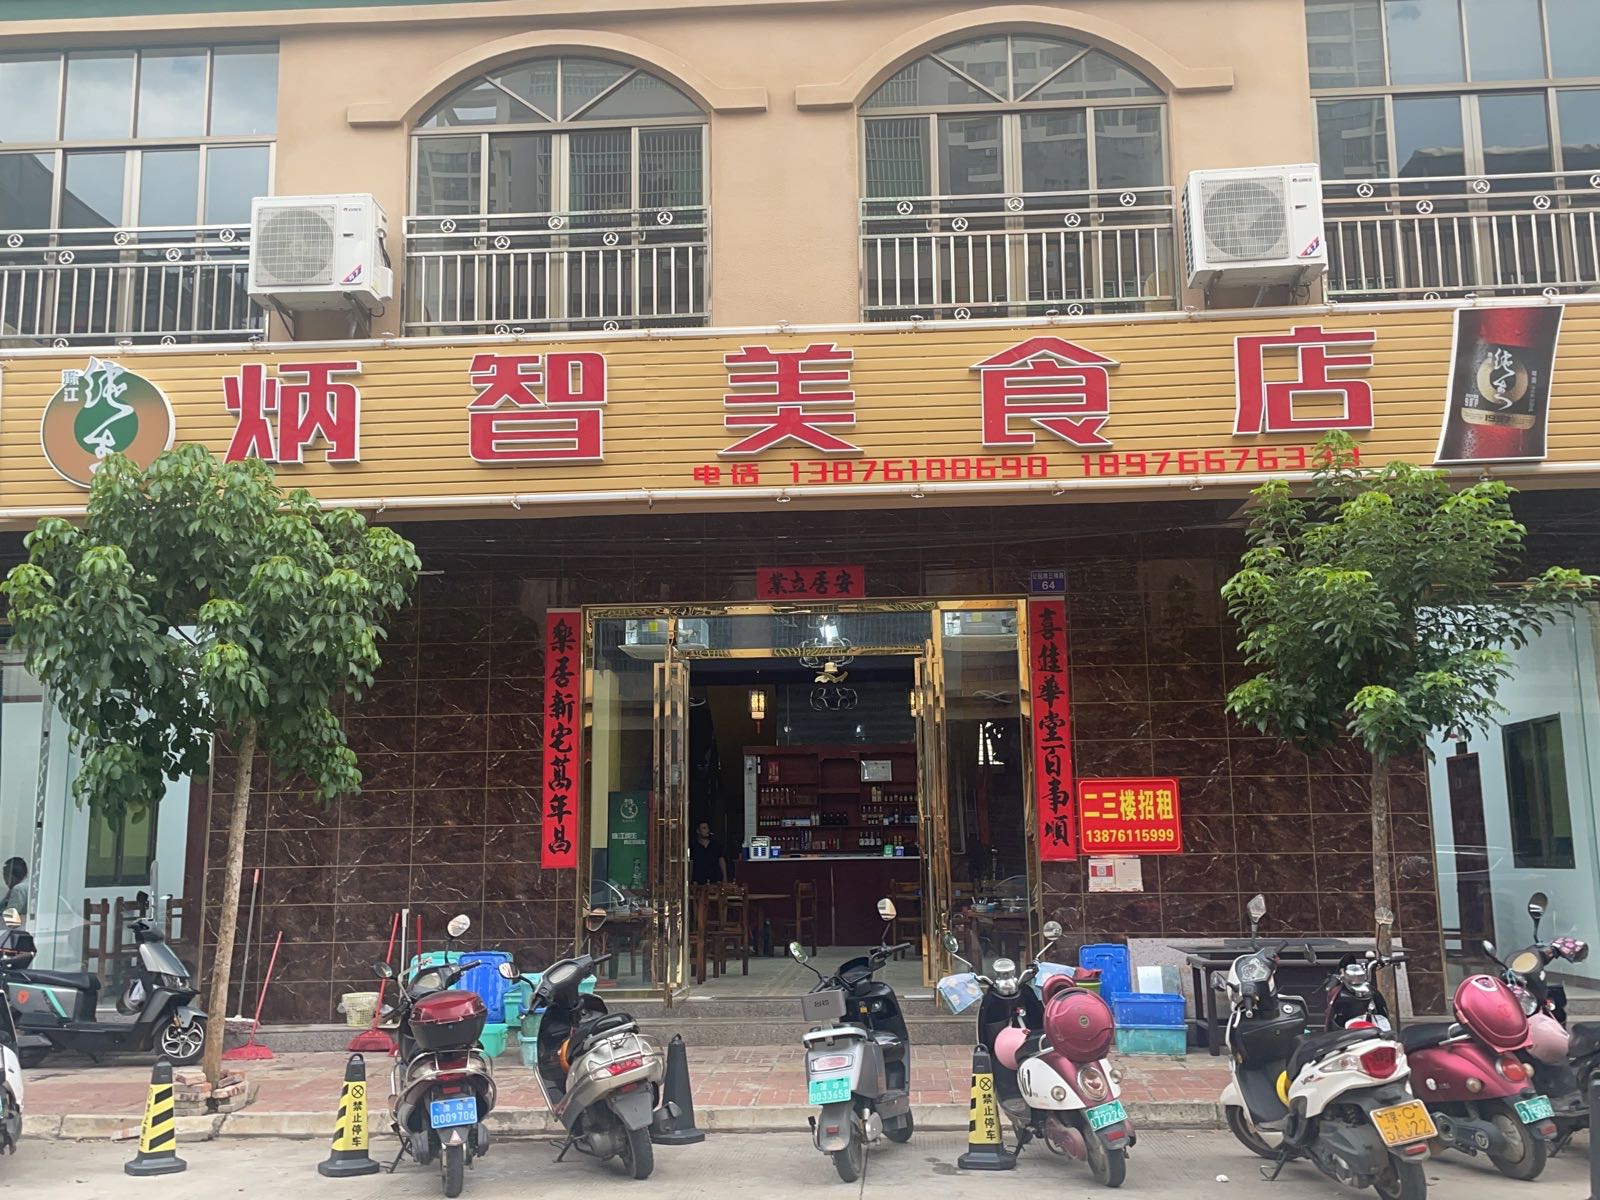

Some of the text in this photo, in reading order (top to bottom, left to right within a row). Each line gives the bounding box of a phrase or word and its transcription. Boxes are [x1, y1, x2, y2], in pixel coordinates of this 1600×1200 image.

[222, 325, 1377, 465] 炳智美食店
[693, 463, 759, 486] 电话
[790, 456, 1047, 484] 13876100690
[1042, 581, 1055, 590] 64
[1084, 789, 1175, 821] 二三楼招租
[1086, 828, 1175, 843] 13876115999
[352, 1101, 363, 1147] 禁止停车
[433, 1110, 475, 1125] 0009706
[982, 1093, 996, 1140] 禁止停车
